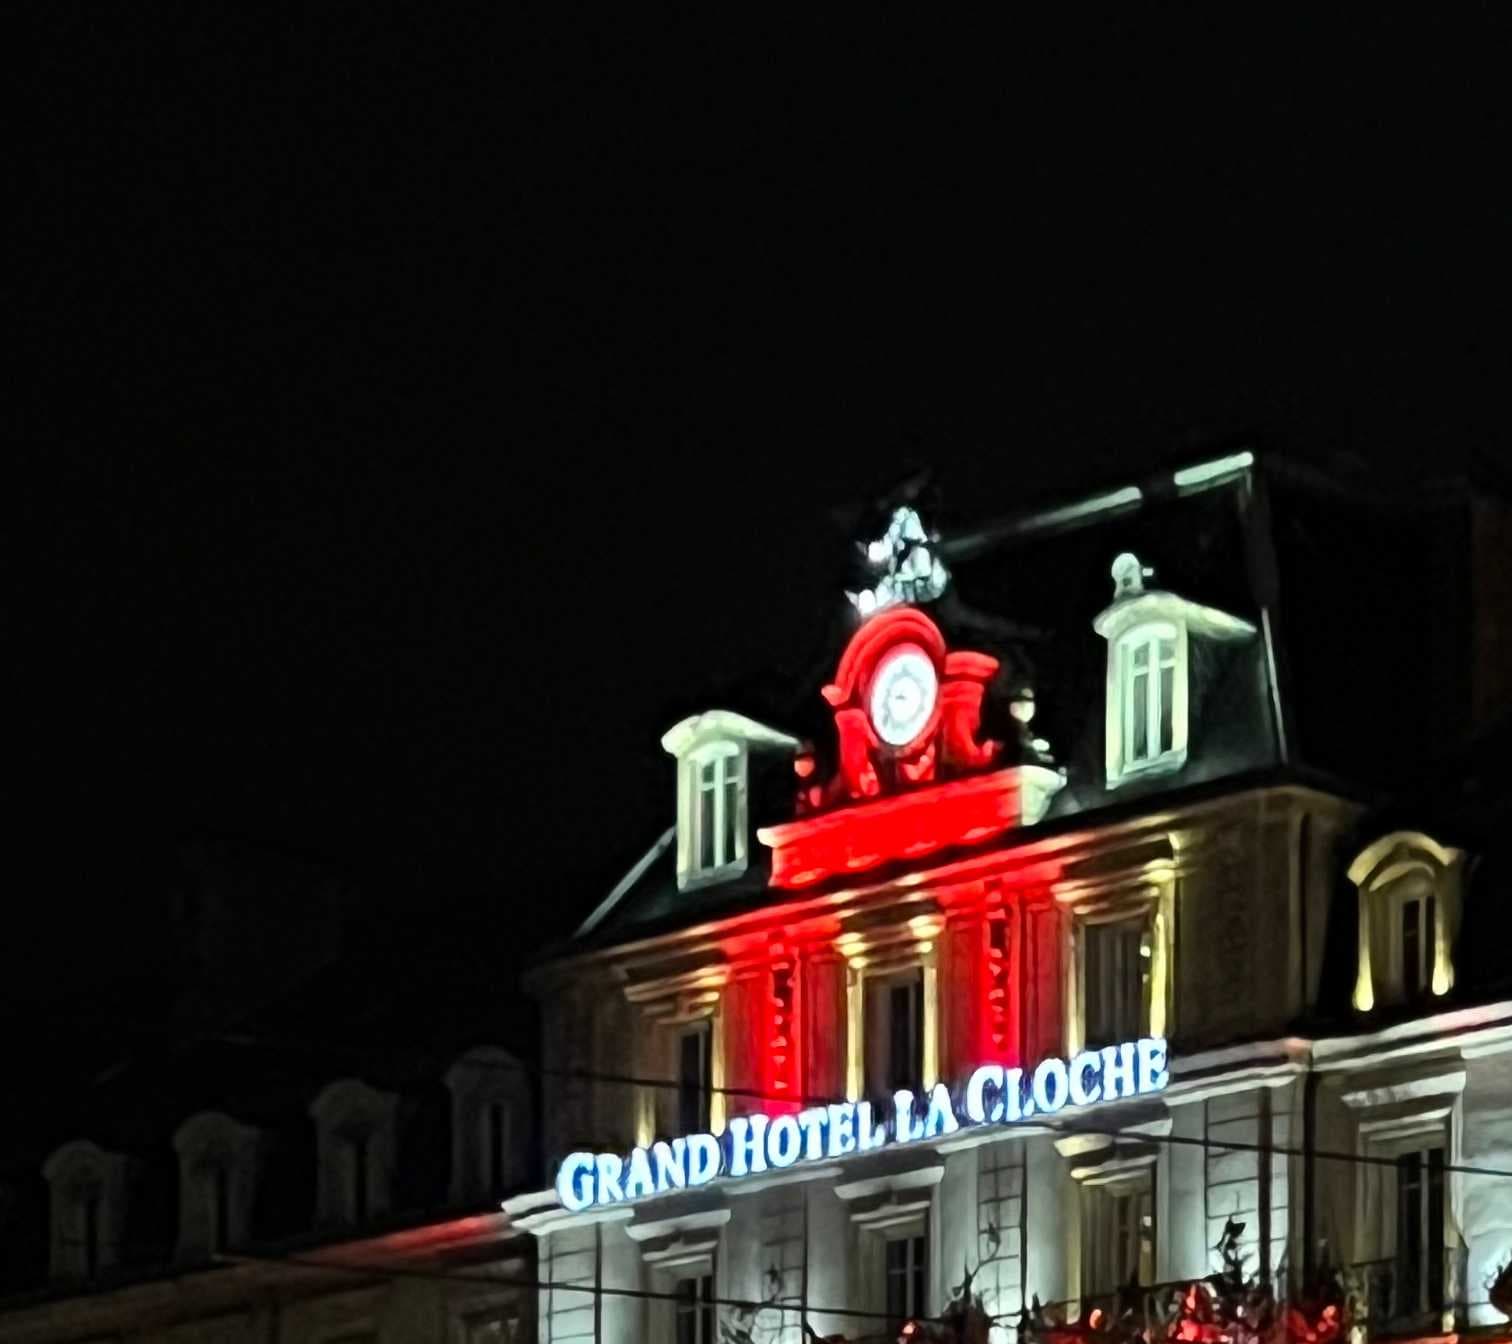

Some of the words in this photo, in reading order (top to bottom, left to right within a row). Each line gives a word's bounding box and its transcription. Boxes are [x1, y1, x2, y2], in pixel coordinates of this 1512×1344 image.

[556, 1134, 721, 1211] GRAND
[729, 1099, 885, 1177] HOTEL
[893, 1085, 958, 1143] LA
[966, 1039, 1170, 1125] CLOCHE
